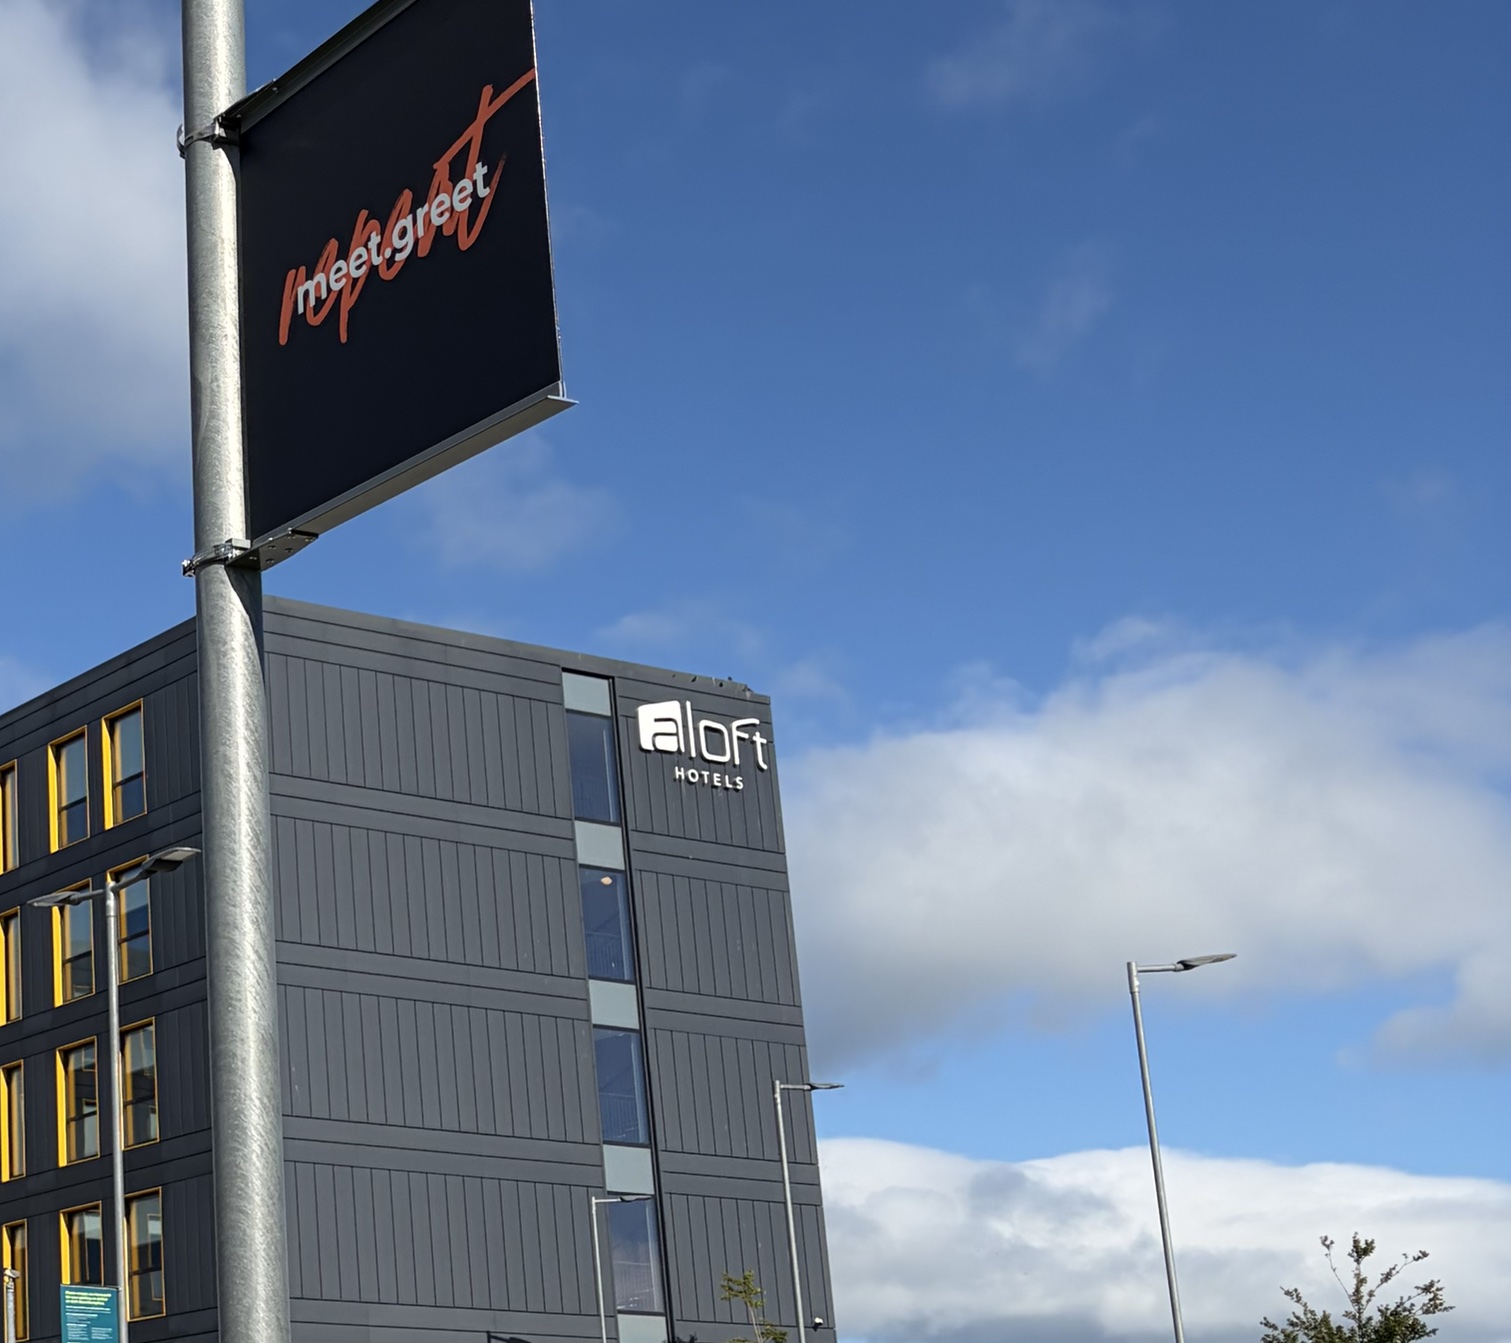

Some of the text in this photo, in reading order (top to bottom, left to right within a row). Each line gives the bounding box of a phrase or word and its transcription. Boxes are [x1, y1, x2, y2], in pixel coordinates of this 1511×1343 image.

[296, 161, 491, 315] meet.greet
[637, 700, 768, 770] aloft
[674, 766, 744, 790] HOTELS
